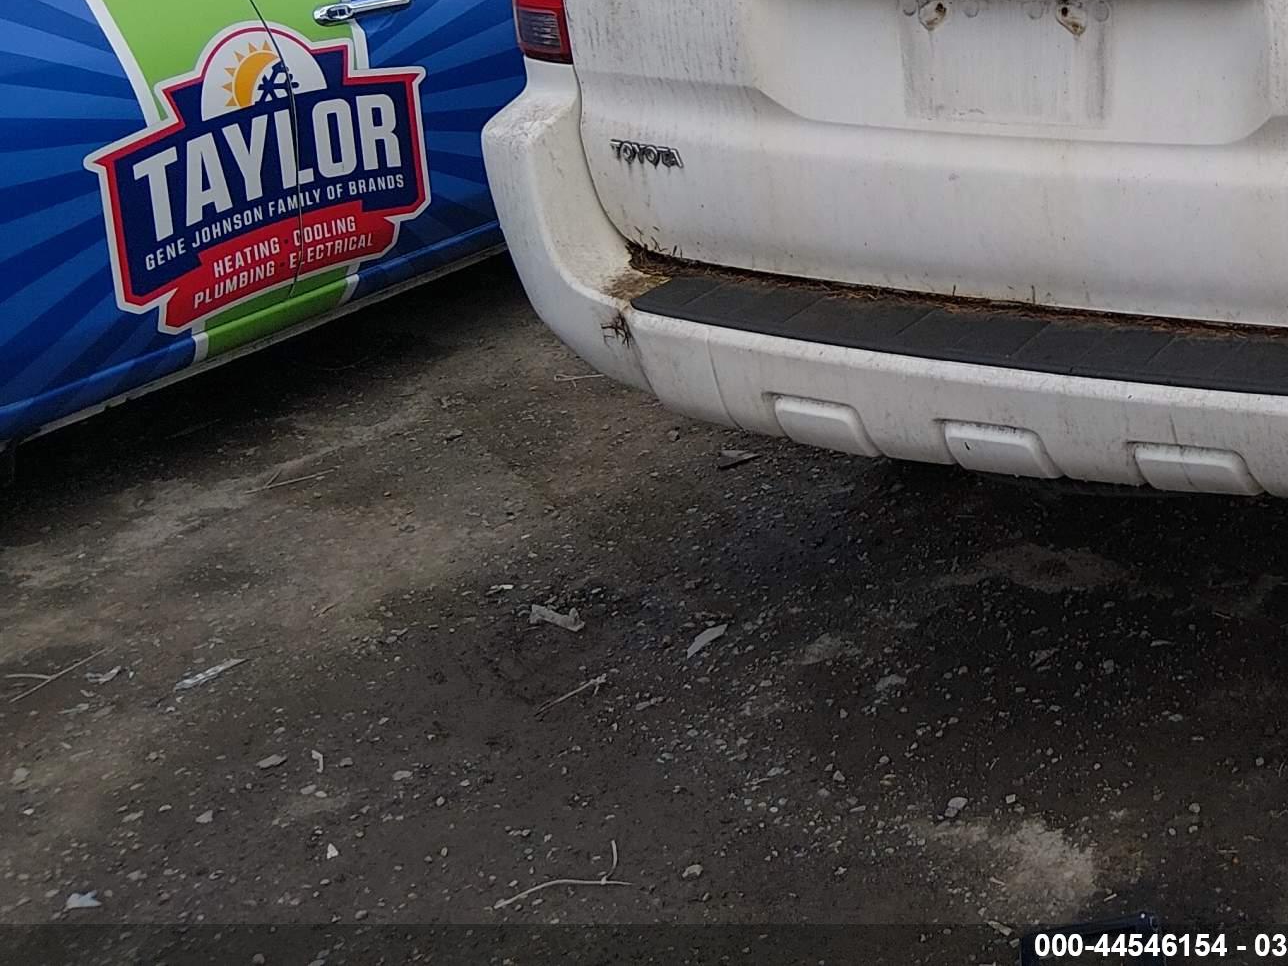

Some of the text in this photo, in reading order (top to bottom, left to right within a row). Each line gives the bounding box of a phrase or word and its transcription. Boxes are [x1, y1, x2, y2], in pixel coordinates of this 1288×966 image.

[133, 94, 401, 242] TAYLOR
[145, 174, 404, 271] GENE JOHNSON FAMILY OF BRANDS
[213, 216, 356, 278] HEATING COOLING
[194, 233, 373, 309] PLUMBING ELECTRICAL
